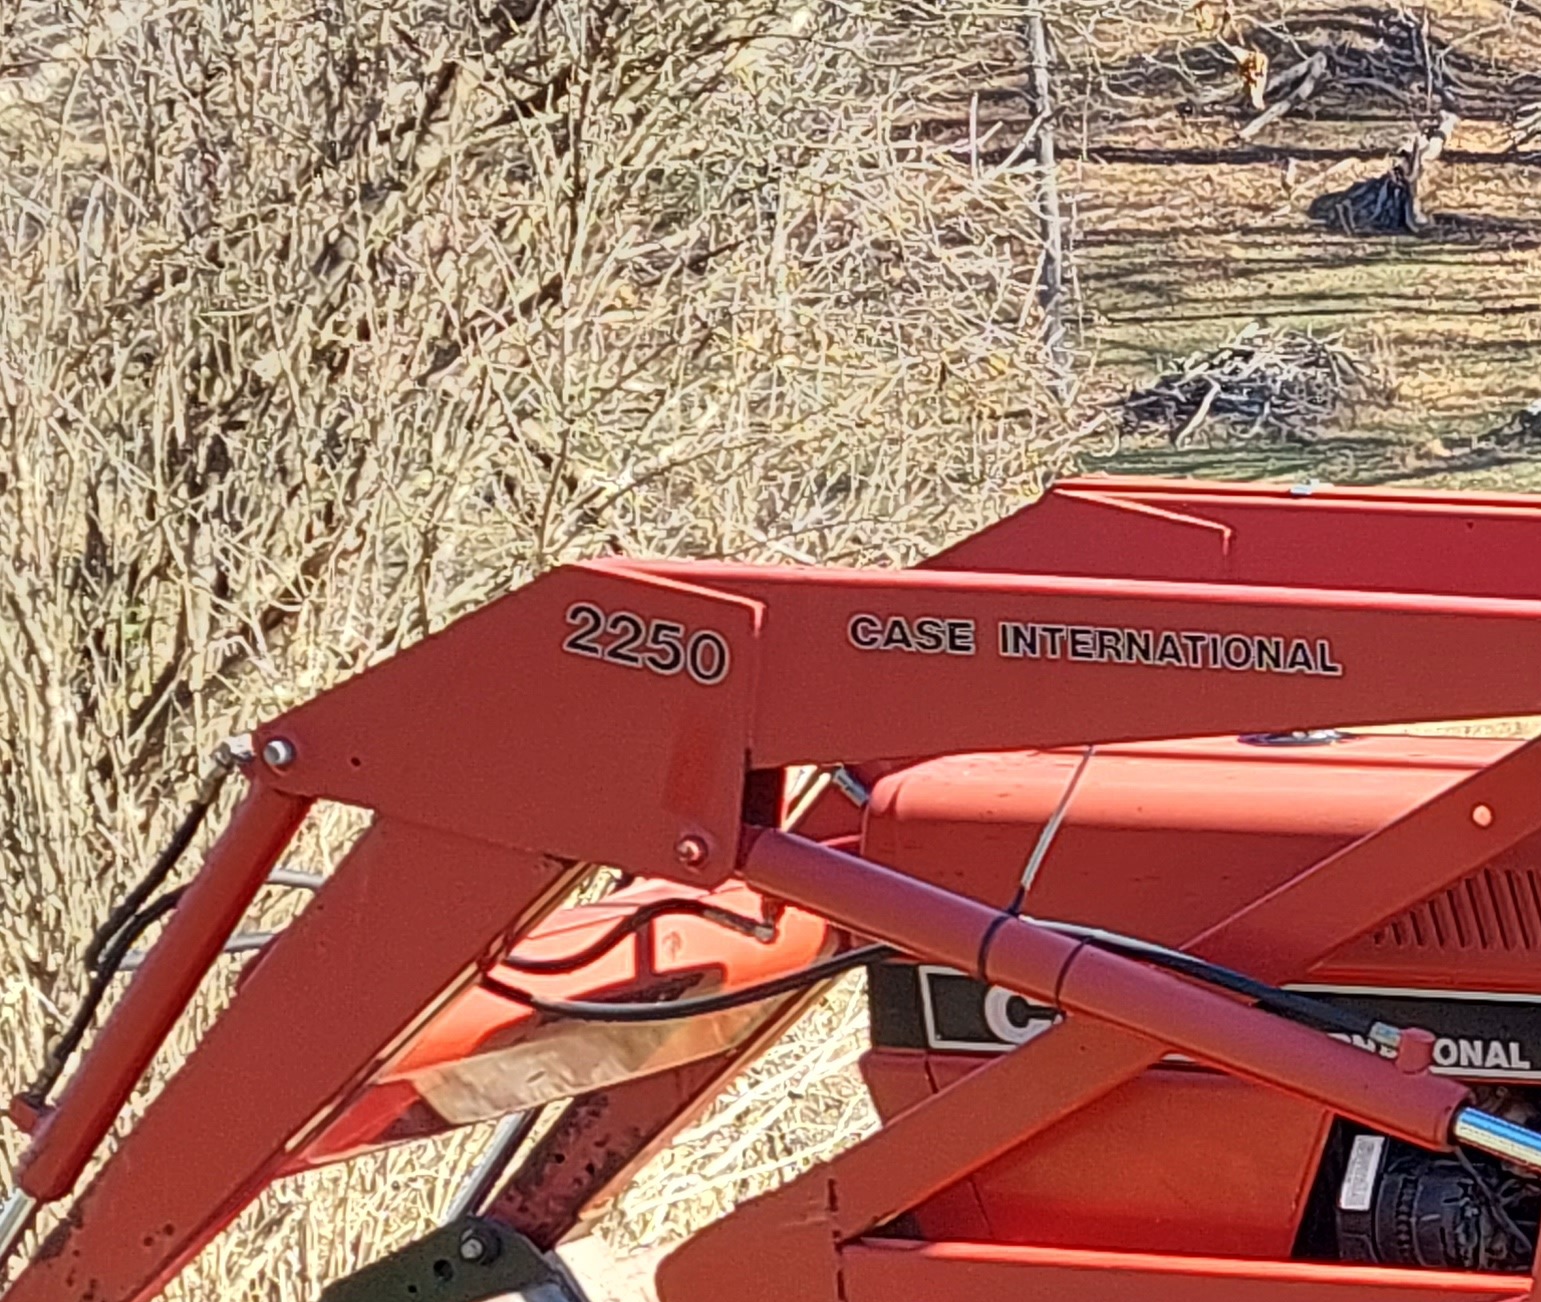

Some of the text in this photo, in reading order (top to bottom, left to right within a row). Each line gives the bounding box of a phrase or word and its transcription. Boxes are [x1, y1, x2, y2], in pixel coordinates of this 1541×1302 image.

[562, 600, 731, 686] 2250
[848, 613, 1343, 677] CASE INTERNATIONAL
